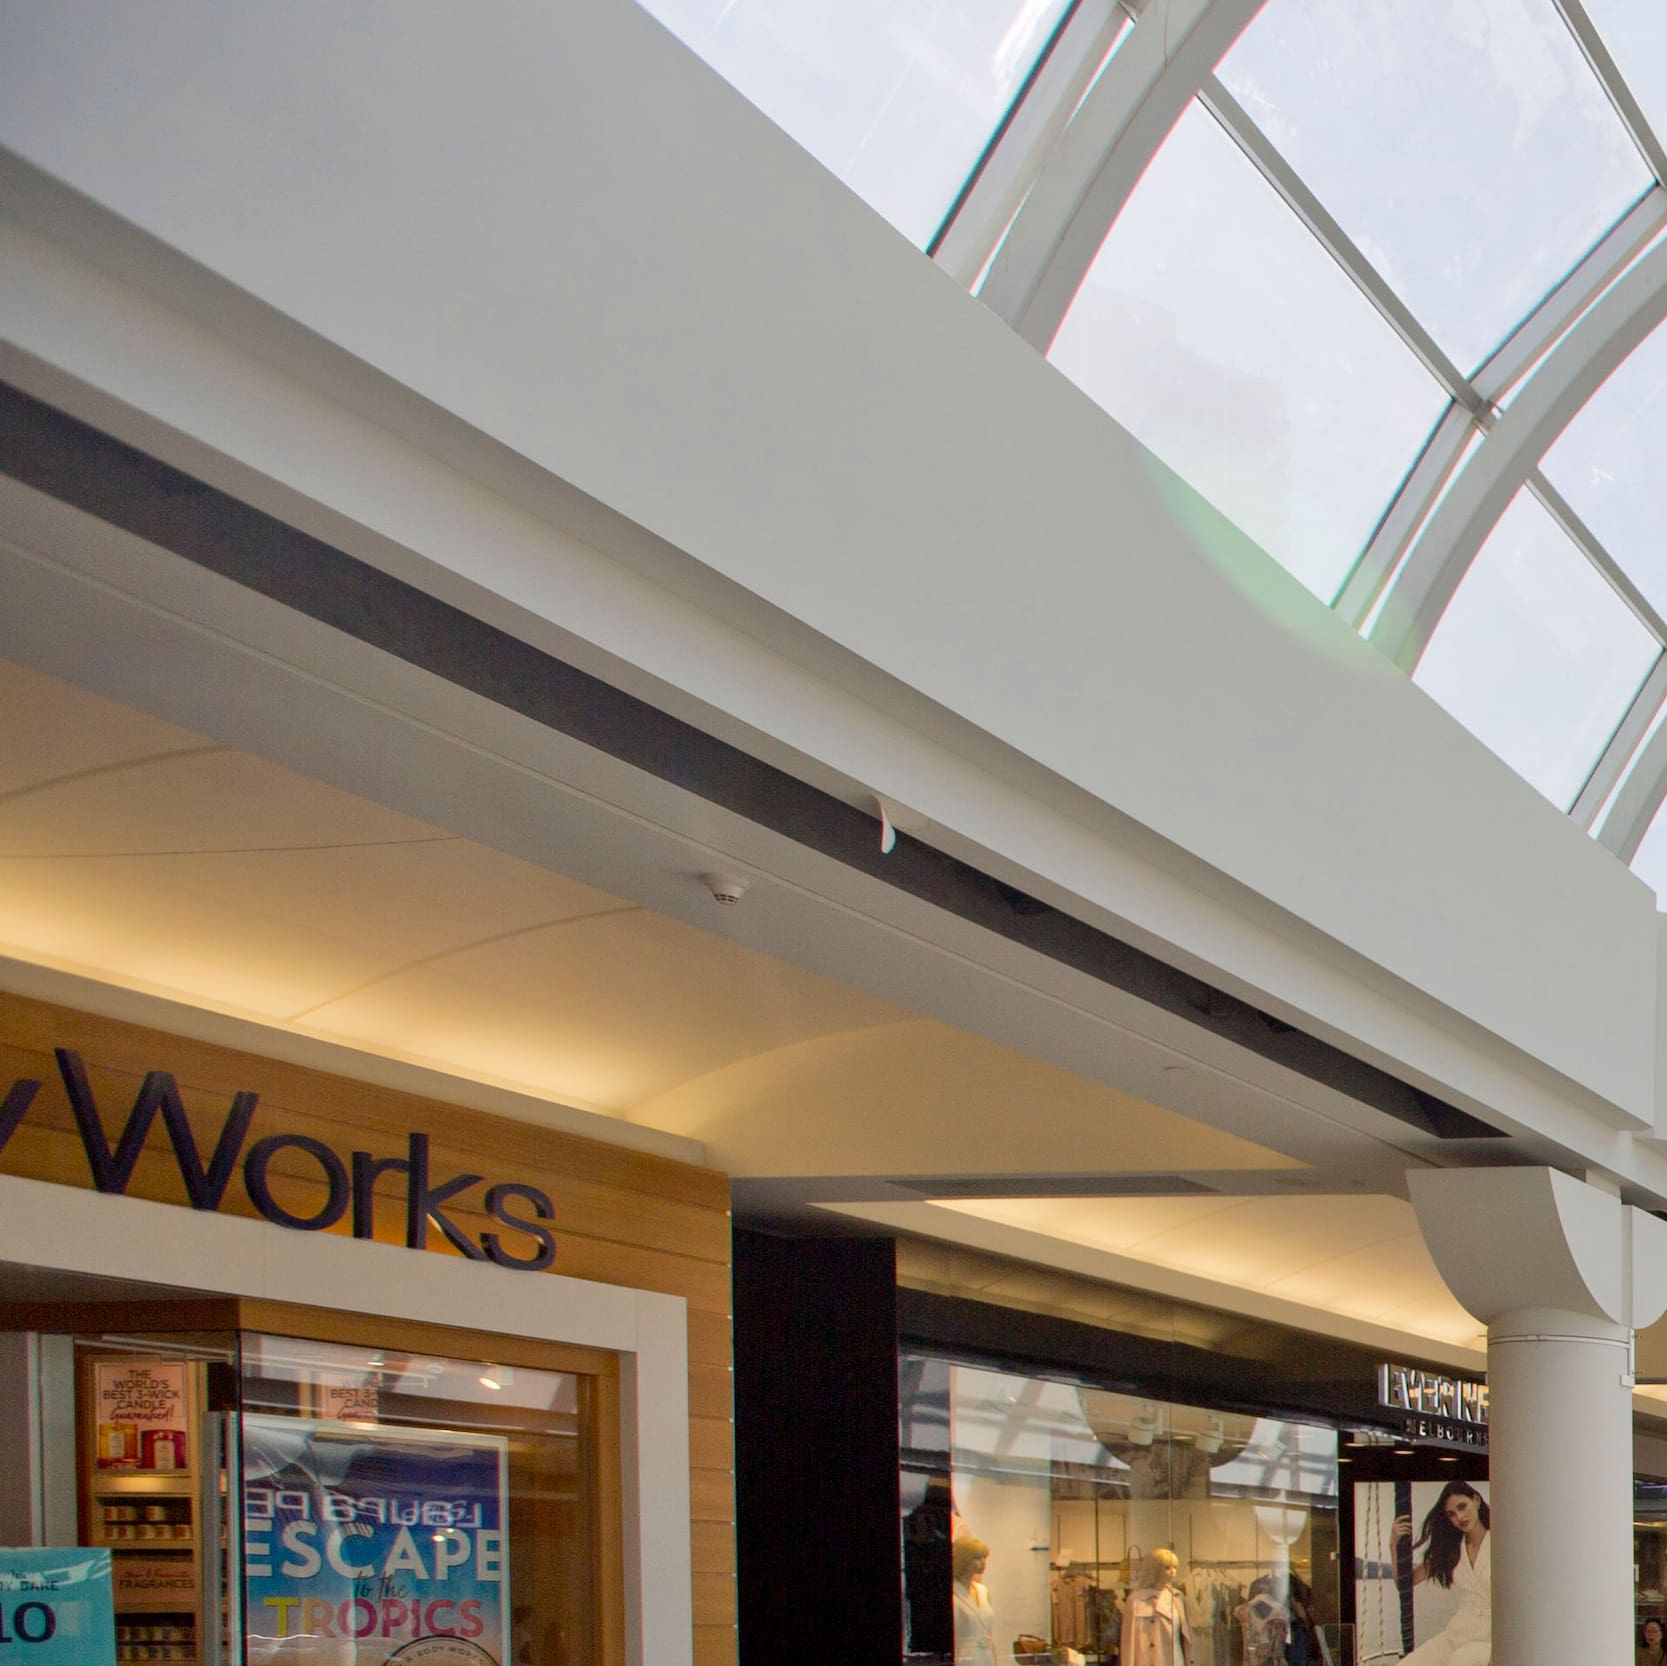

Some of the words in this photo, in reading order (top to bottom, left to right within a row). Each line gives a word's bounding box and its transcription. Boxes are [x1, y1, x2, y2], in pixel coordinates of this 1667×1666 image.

[54, 1047, 557, 1271] Works
[128, 1369, 152, 1379] THE
[113, 1379, 170, 1389] WORLD'S
[103, 1389, 133, 1399] BEST
[136, 1389, 181, 1400] 3-WICK
[330, 1388, 360, 1399] BEST
[116, 1399, 167, 1410] CANDLE
[246, 1518, 501, 1583] ESCAPE
[119, 1578, 196, 1590] FRAGRANCES
[353, 1571, 373, 1598] to
[377, 1570, 410, 1603] the
[263, 1596, 485, 1639] TROPICS
